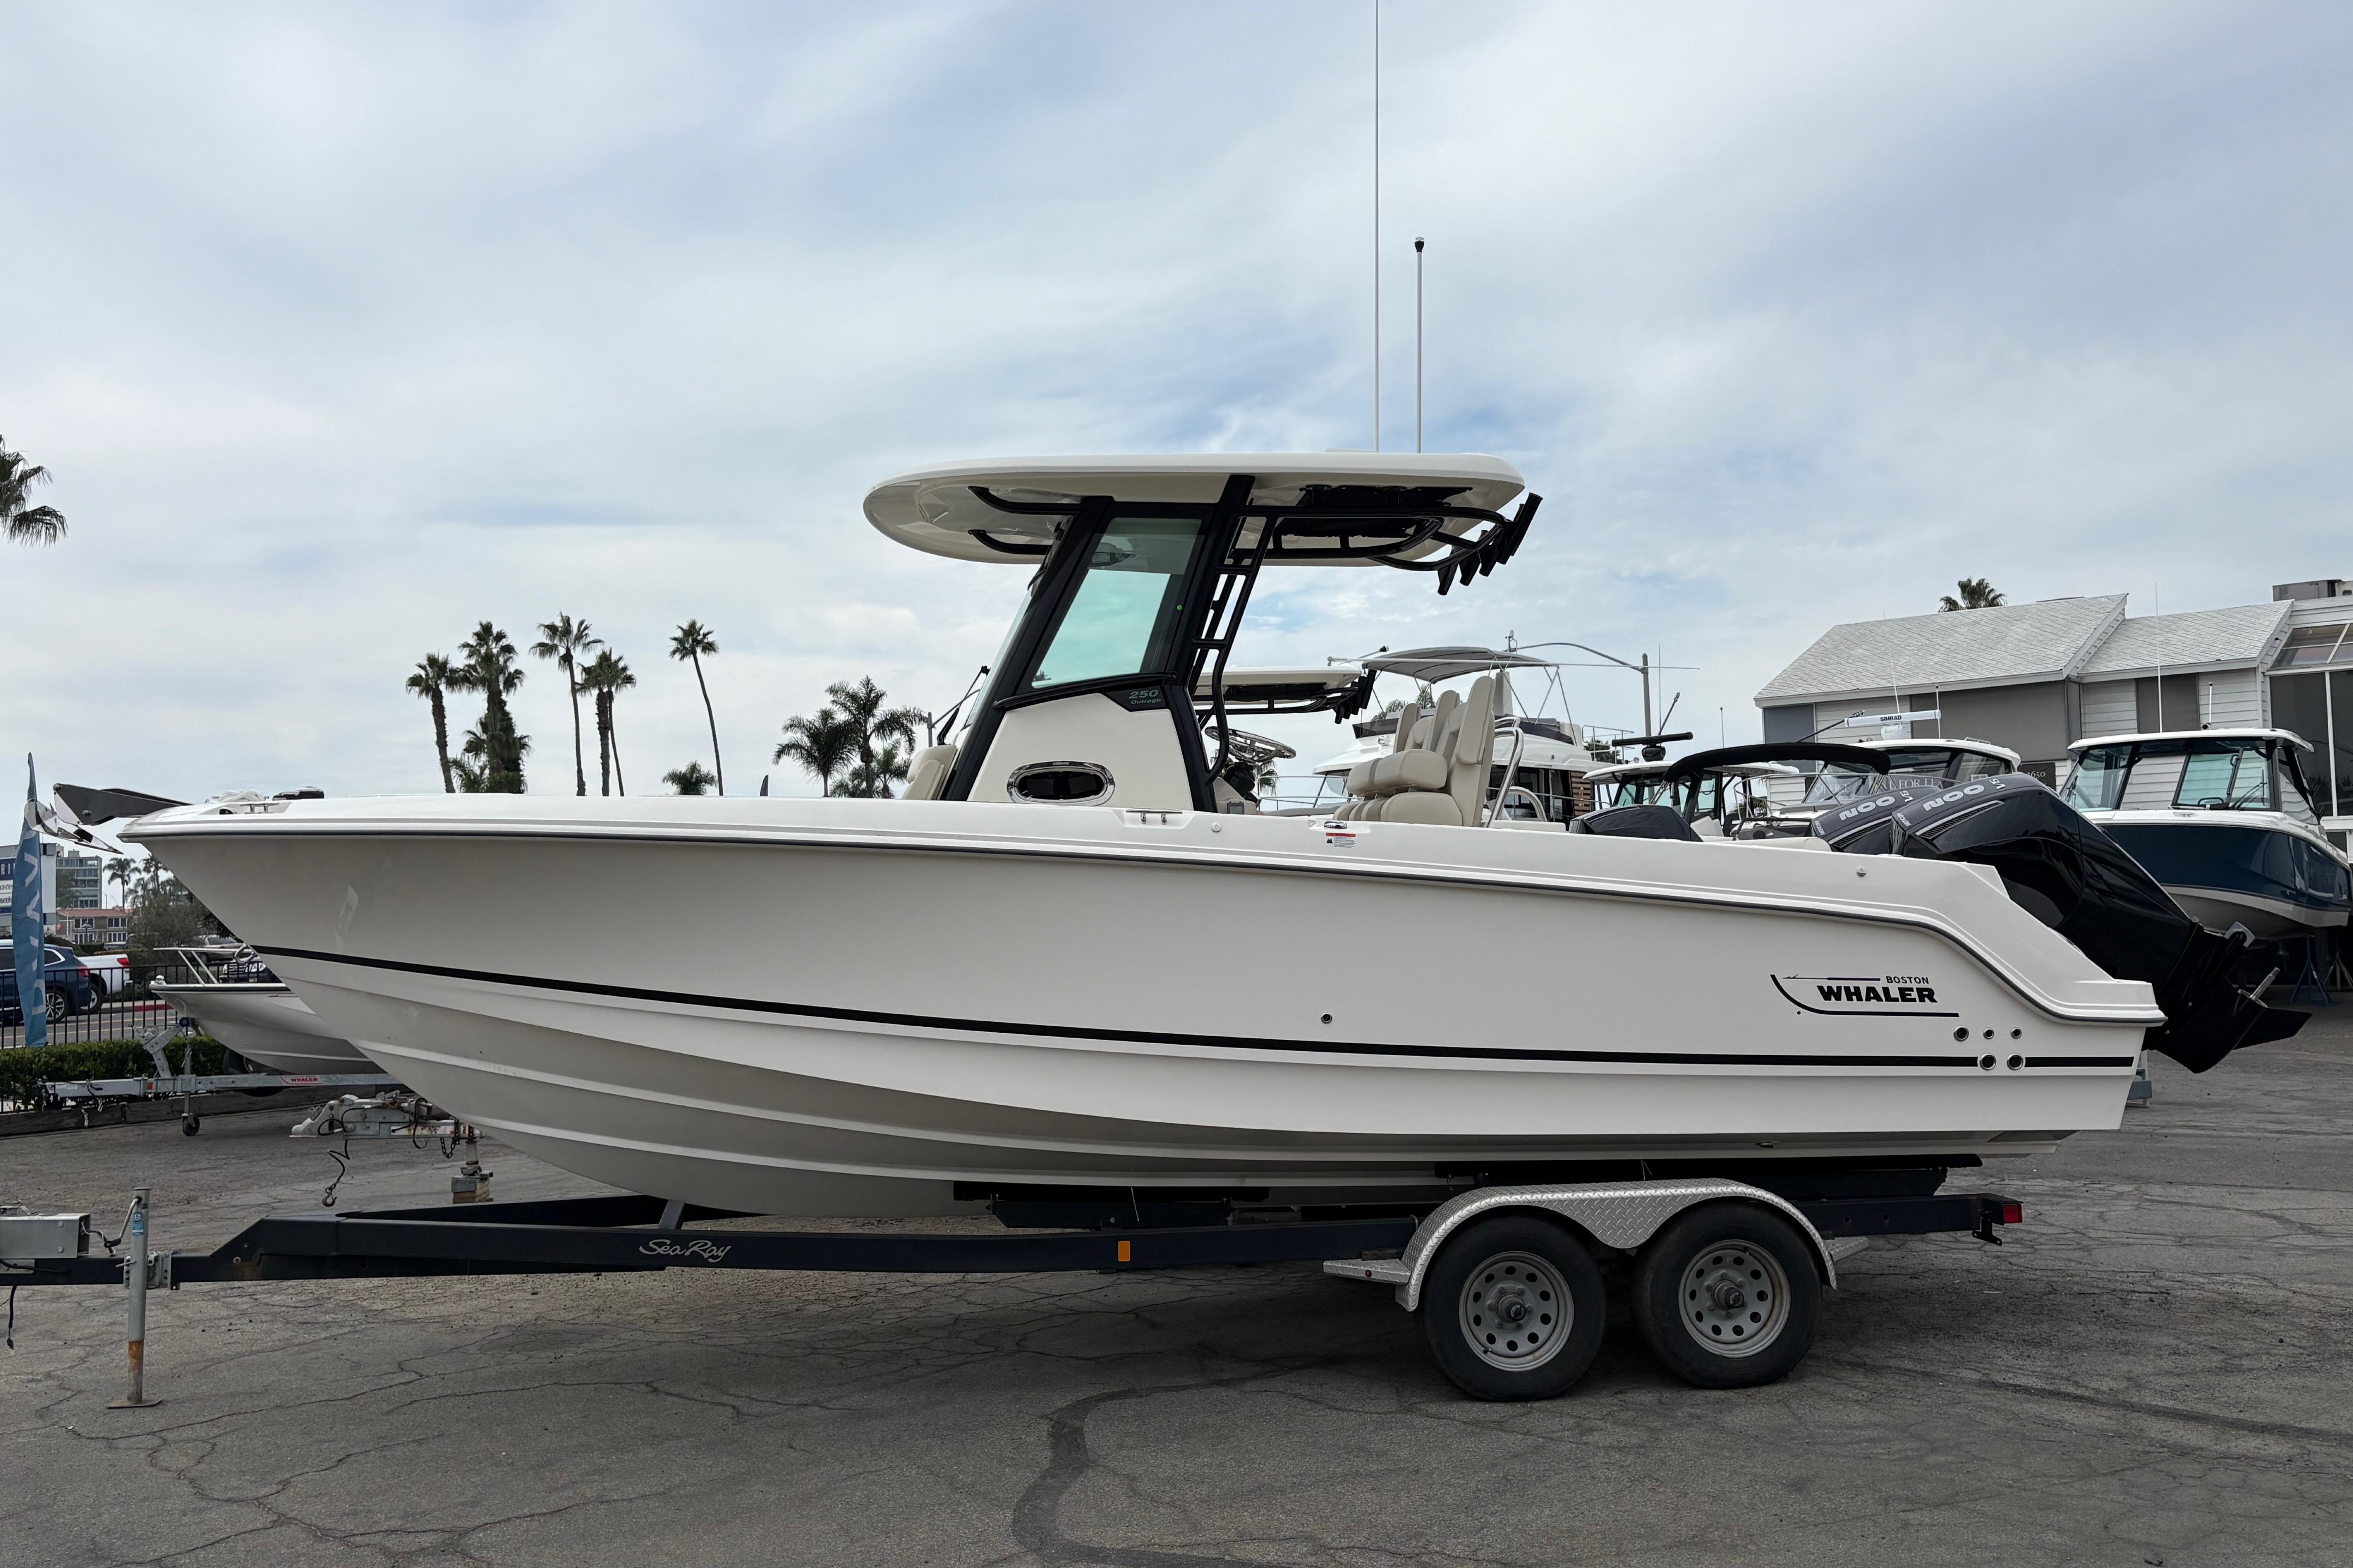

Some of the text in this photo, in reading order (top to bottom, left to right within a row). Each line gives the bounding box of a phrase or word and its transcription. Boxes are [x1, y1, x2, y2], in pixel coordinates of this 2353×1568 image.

[1129, 690, 1159, 699] 250
[1817, 985, 1938, 1003] WHALER
[639, 1239, 732, 1263] Sea Ray
